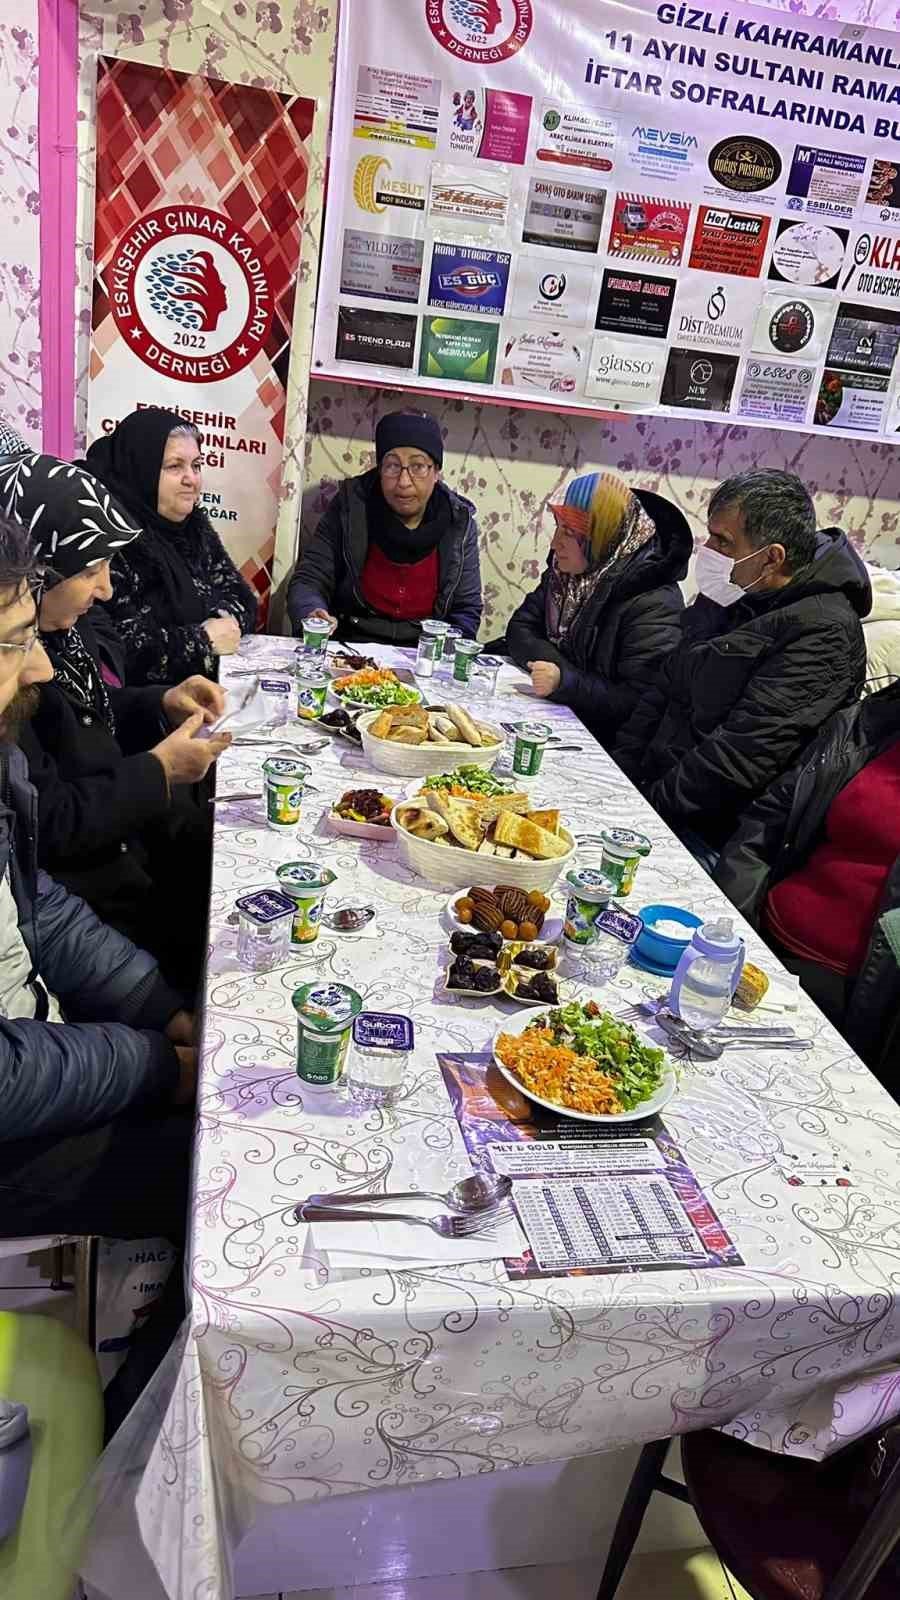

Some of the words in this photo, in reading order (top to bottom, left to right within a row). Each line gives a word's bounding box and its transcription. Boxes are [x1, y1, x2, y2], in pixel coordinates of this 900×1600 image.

[656, 2, 729, 36] GİZLİ
[465, 33, 488, 45] 2022
[605, 30, 633, 53] 11
[642, 38, 707, 67] AYIN
[713, 52, 825, 90] SULTANI
[584, 58, 663, 96] İFTAR
[669, 79, 866, 134] SOFRALARINDA
[449, 131, 475, 144] ÖNDER
[631, 125, 698, 148] MEVSİM
[816, 157, 834, 165] MALİ
[380, 178, 424, 197] MESUT
[552, 186, 566, 198] OTO
[381, 195, 393, 203] ROT
[806, 200, 853, 214] ESBİLDER
[367, 240, 400, 256] YILDIZ
[116, 219, 163, 319] ESKİŞEHİR
[164, 211, 227, 240] ÇINAR
[227, 231, 270, 343] KADINLARI
[441, 275, 463, 286] ES
[466, 271, 497, 287] GÜÇ
[857, 273, 873, 292] OTO
[703, 320, 744, 340] PREMIUM
[172, 331, 207, 350] 2022
[344, 332, 356, 342] ES
[357, 334, 384, 345] TREND
[384, 338, 411, 349] PLAZA
[144, 343, 233, 377] DERNEĞİ
[597, 353, 652, 376] giasso
